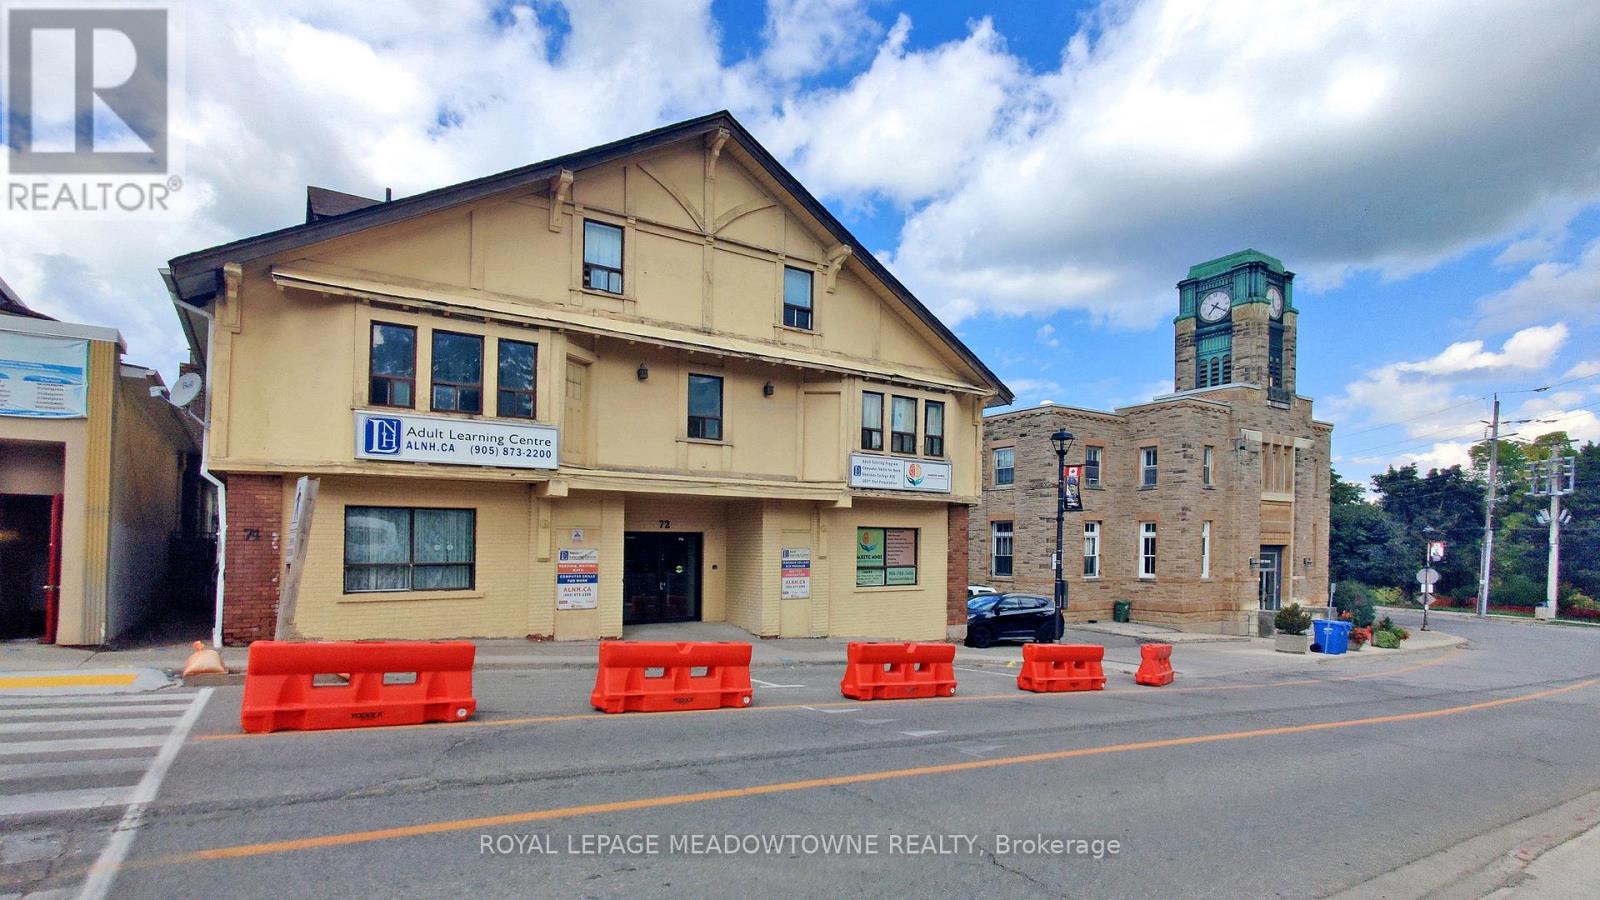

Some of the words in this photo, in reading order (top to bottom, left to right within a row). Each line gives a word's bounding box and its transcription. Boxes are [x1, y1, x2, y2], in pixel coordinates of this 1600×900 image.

[406, 426, 444, 440] Adult
[449, 429, 505, 446] Learning
[508, 434, 552, 447] Centre
[406, 440, 455, 453] ALNH.CA
[470, 445, 499, 457] (905)
[659, 519, 671, 529] 72
